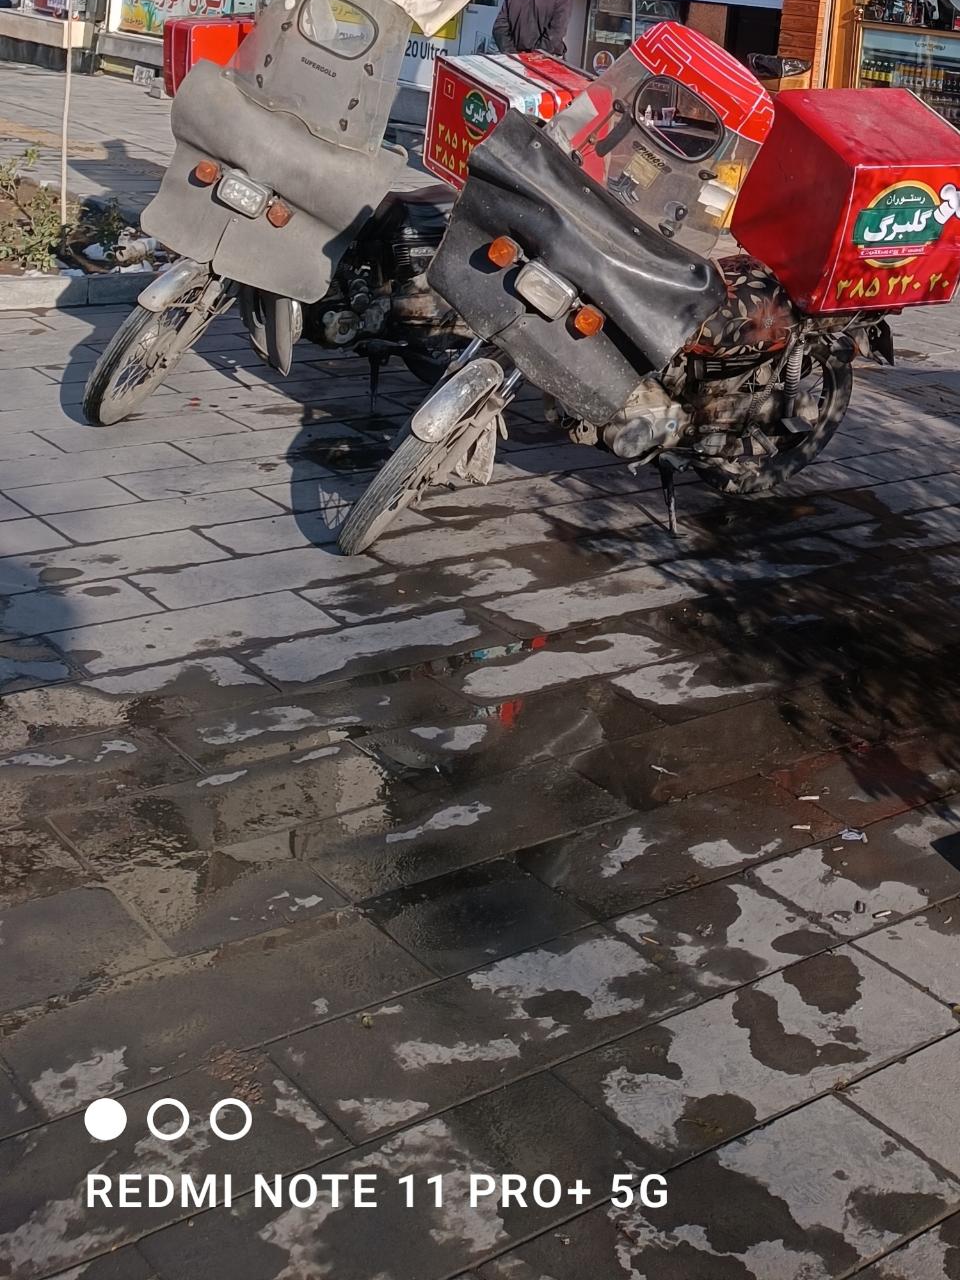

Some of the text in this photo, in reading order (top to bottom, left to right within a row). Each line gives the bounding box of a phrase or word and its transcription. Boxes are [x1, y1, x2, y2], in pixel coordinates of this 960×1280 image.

[420, 41, 449, 62] Ultra
[301, 56, 338, 79] SUPERGOLD
[438, 122, 475, 155] ۳۸۵ ۲۲
[435, 144, 455, 171] ۳۸۵
[885, 193, 927, 207] رستوران
[862, 208, 933, 243] گلبرگ
[836, 272, 950, 301] ۳۸۵ ۲۲۰ ۲۰
